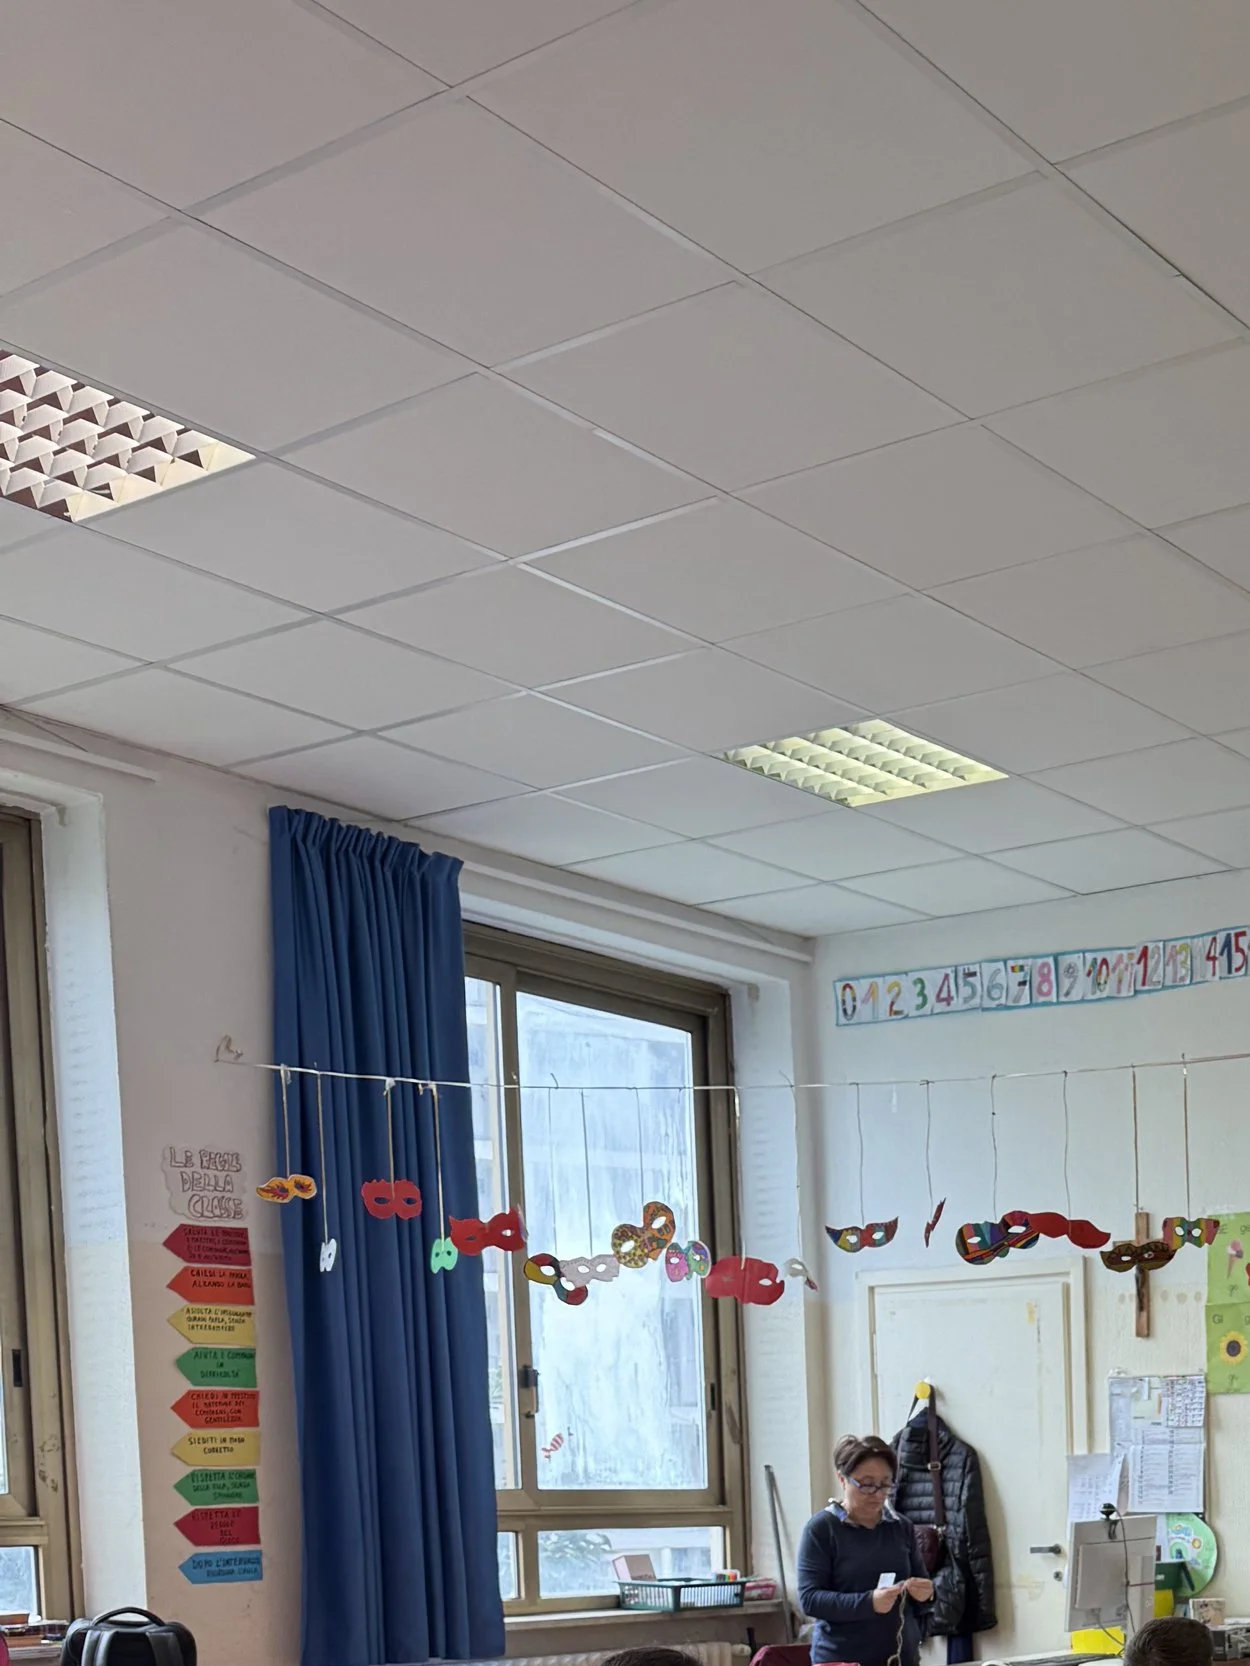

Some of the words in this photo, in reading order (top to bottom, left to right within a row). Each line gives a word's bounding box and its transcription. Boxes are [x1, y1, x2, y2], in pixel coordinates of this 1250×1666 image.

[841, 983, 856, 1021] 0
[861, 981, 879, 1020] 1
[887, 980, 904, 1016] 2
[913, 977, 928, 1010] 3
[936, 973, 953, 1007] 4
[962, 968, 977, 1003] 5
[987, 969, 1004, 1001] 6
[1036, 962, 1053, 997] 8
[1063, 965, 1079, 997] 9
[1086, 957, 1109, 994] 10
[1137, 945, 1162, 987] 12
[1166, 943, 1190, 983] 13
[1220, 931, 1247, 974] 15
[169, 1147, 194, 1168] LE
[180, 1171, 233, 1193] DELLA
[188, 1194, 244, 1219] CLASSE
